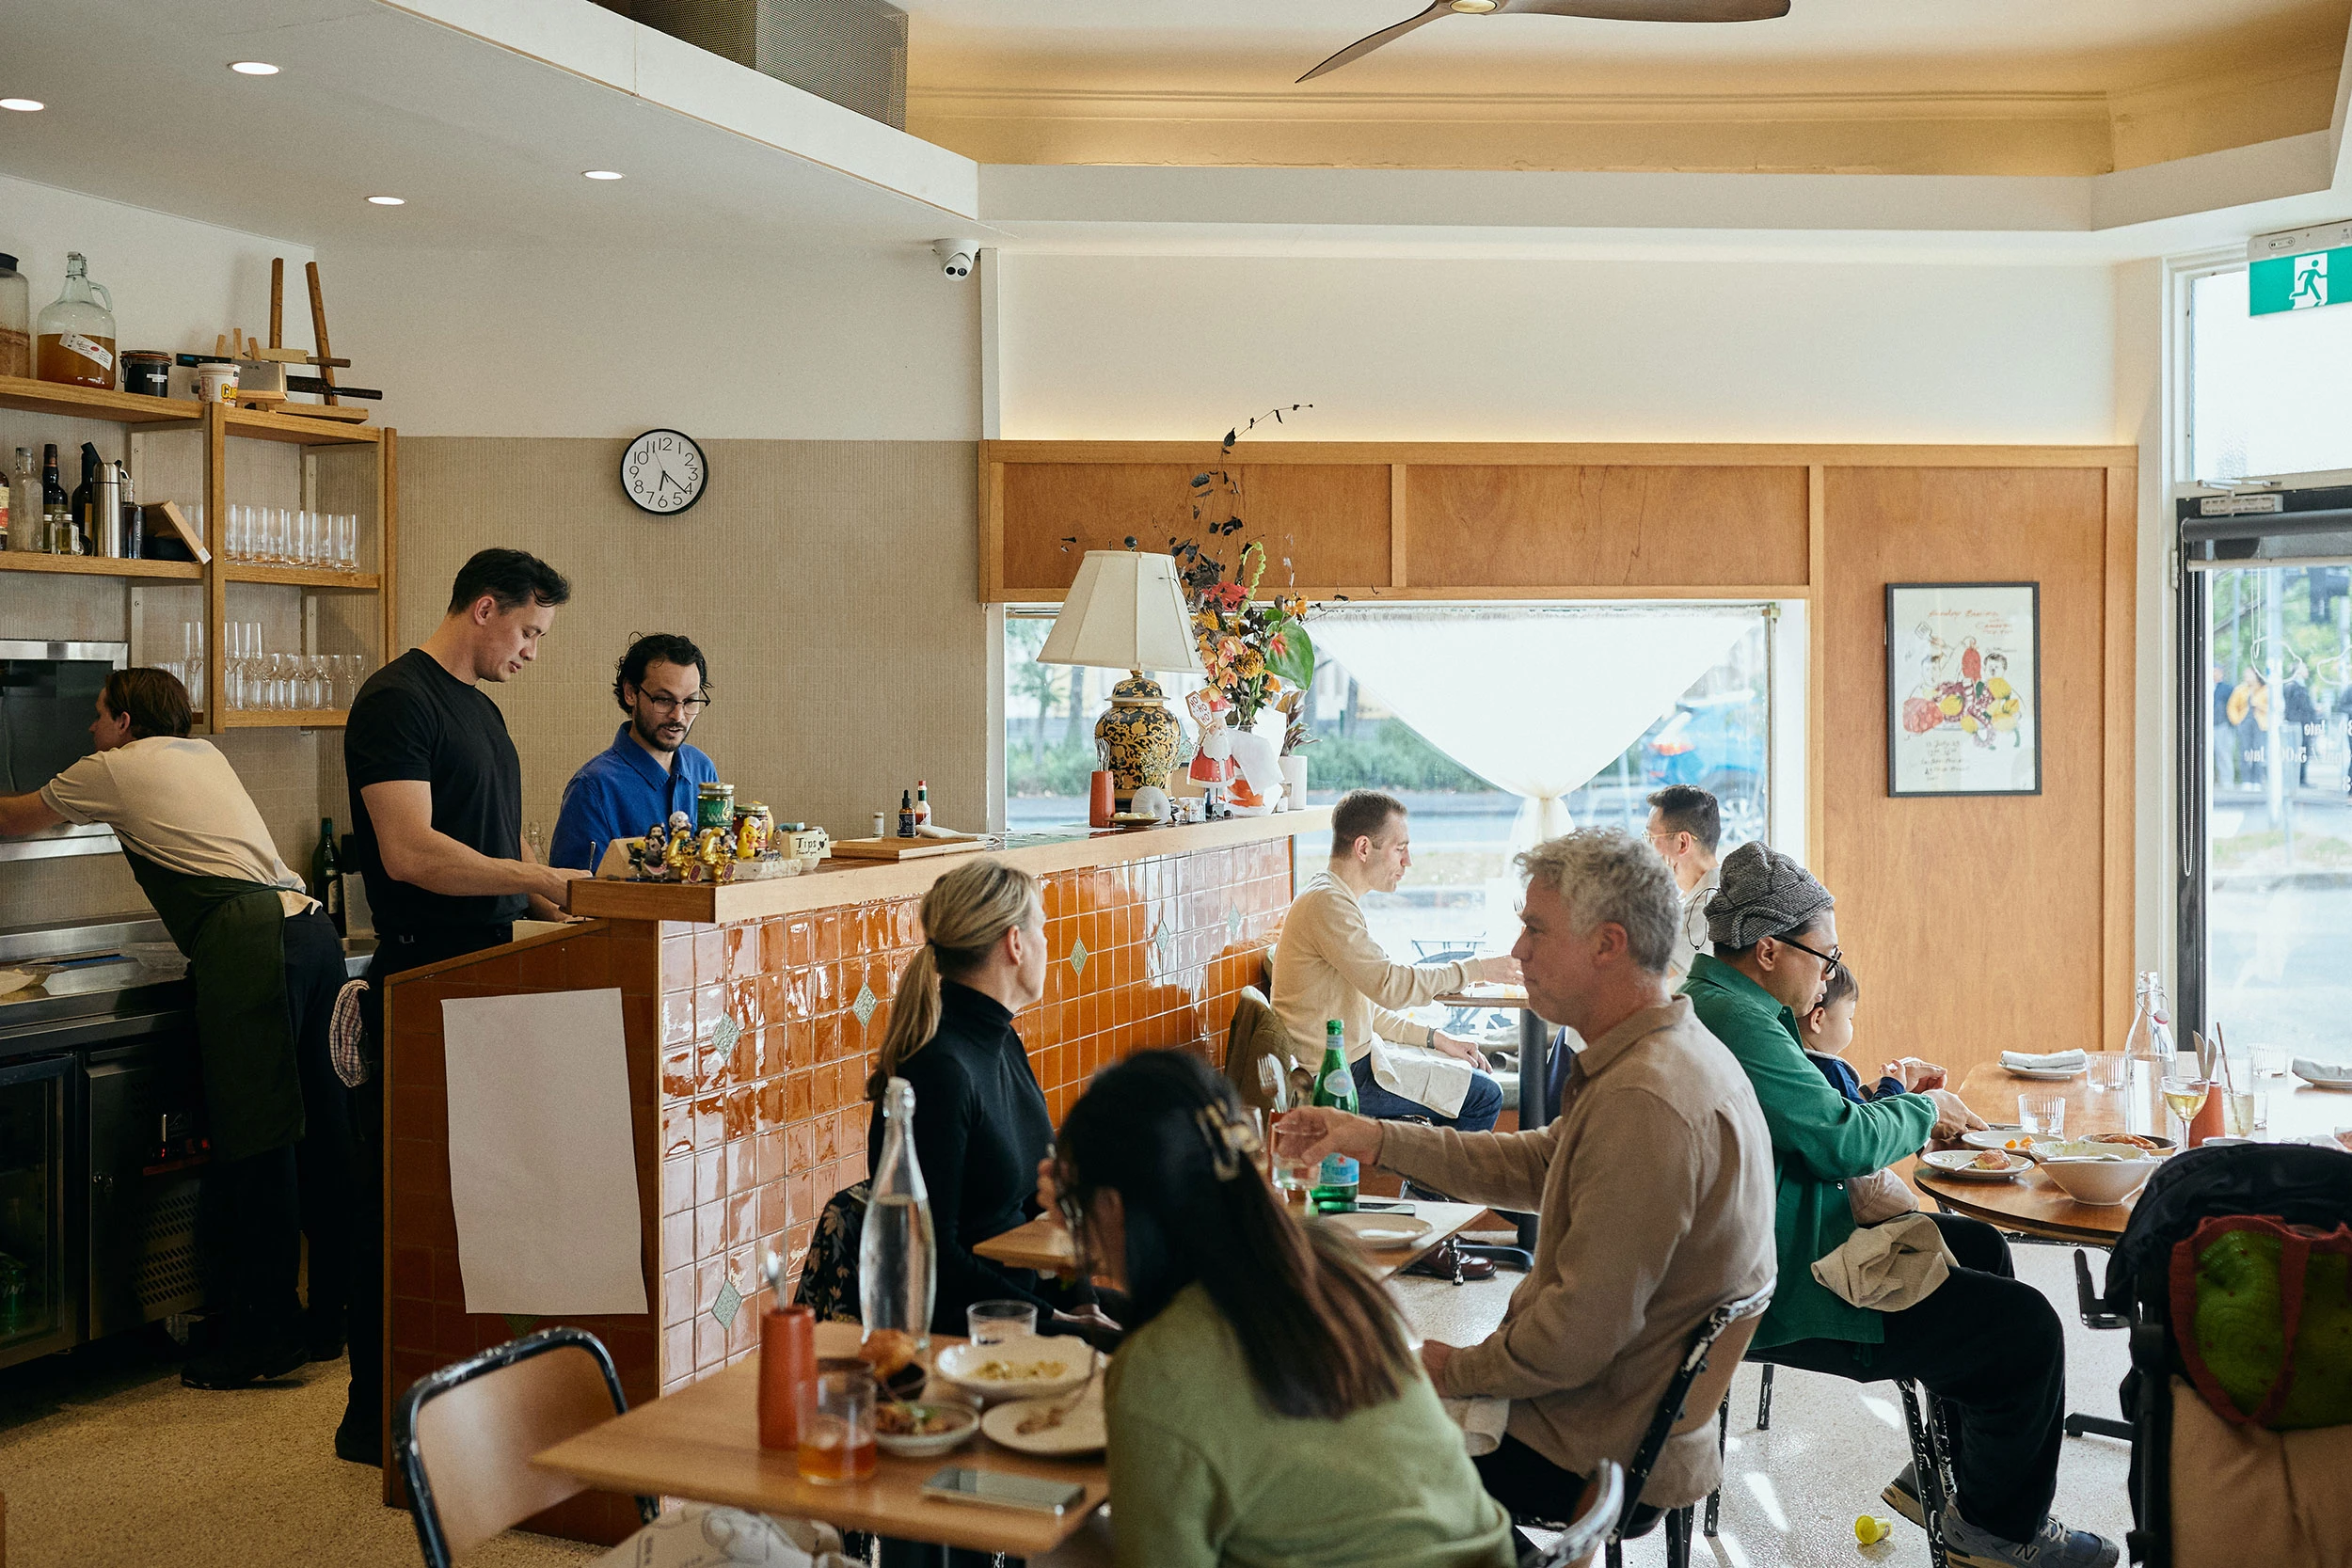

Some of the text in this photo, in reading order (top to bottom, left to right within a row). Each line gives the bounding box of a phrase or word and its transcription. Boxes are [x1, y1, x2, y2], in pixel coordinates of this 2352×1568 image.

[646, 441, 656, 453] 11
[659, 437, 673, 451] 12
[633, 451, 649, 465] 10
[684, 452, 694, 467] 2
[629, 466, 640, 479] 9
[688, 467, 698, 481] 3
[633, 480, 644, 494] 8
[684, 483, 692, 495] 4
[646, 491, 655, 504] 7
[658, 495, 668, 508] 6
[673, 492, 682, 505] 5
[1190, 696, 1199, 708] HO
[1198, 704, 1207, 712] HO
[1200, 714, 1210, 723] HO
[795, 837, 816, 852] Tips
[2013, 1544, 2039, 1562] N
